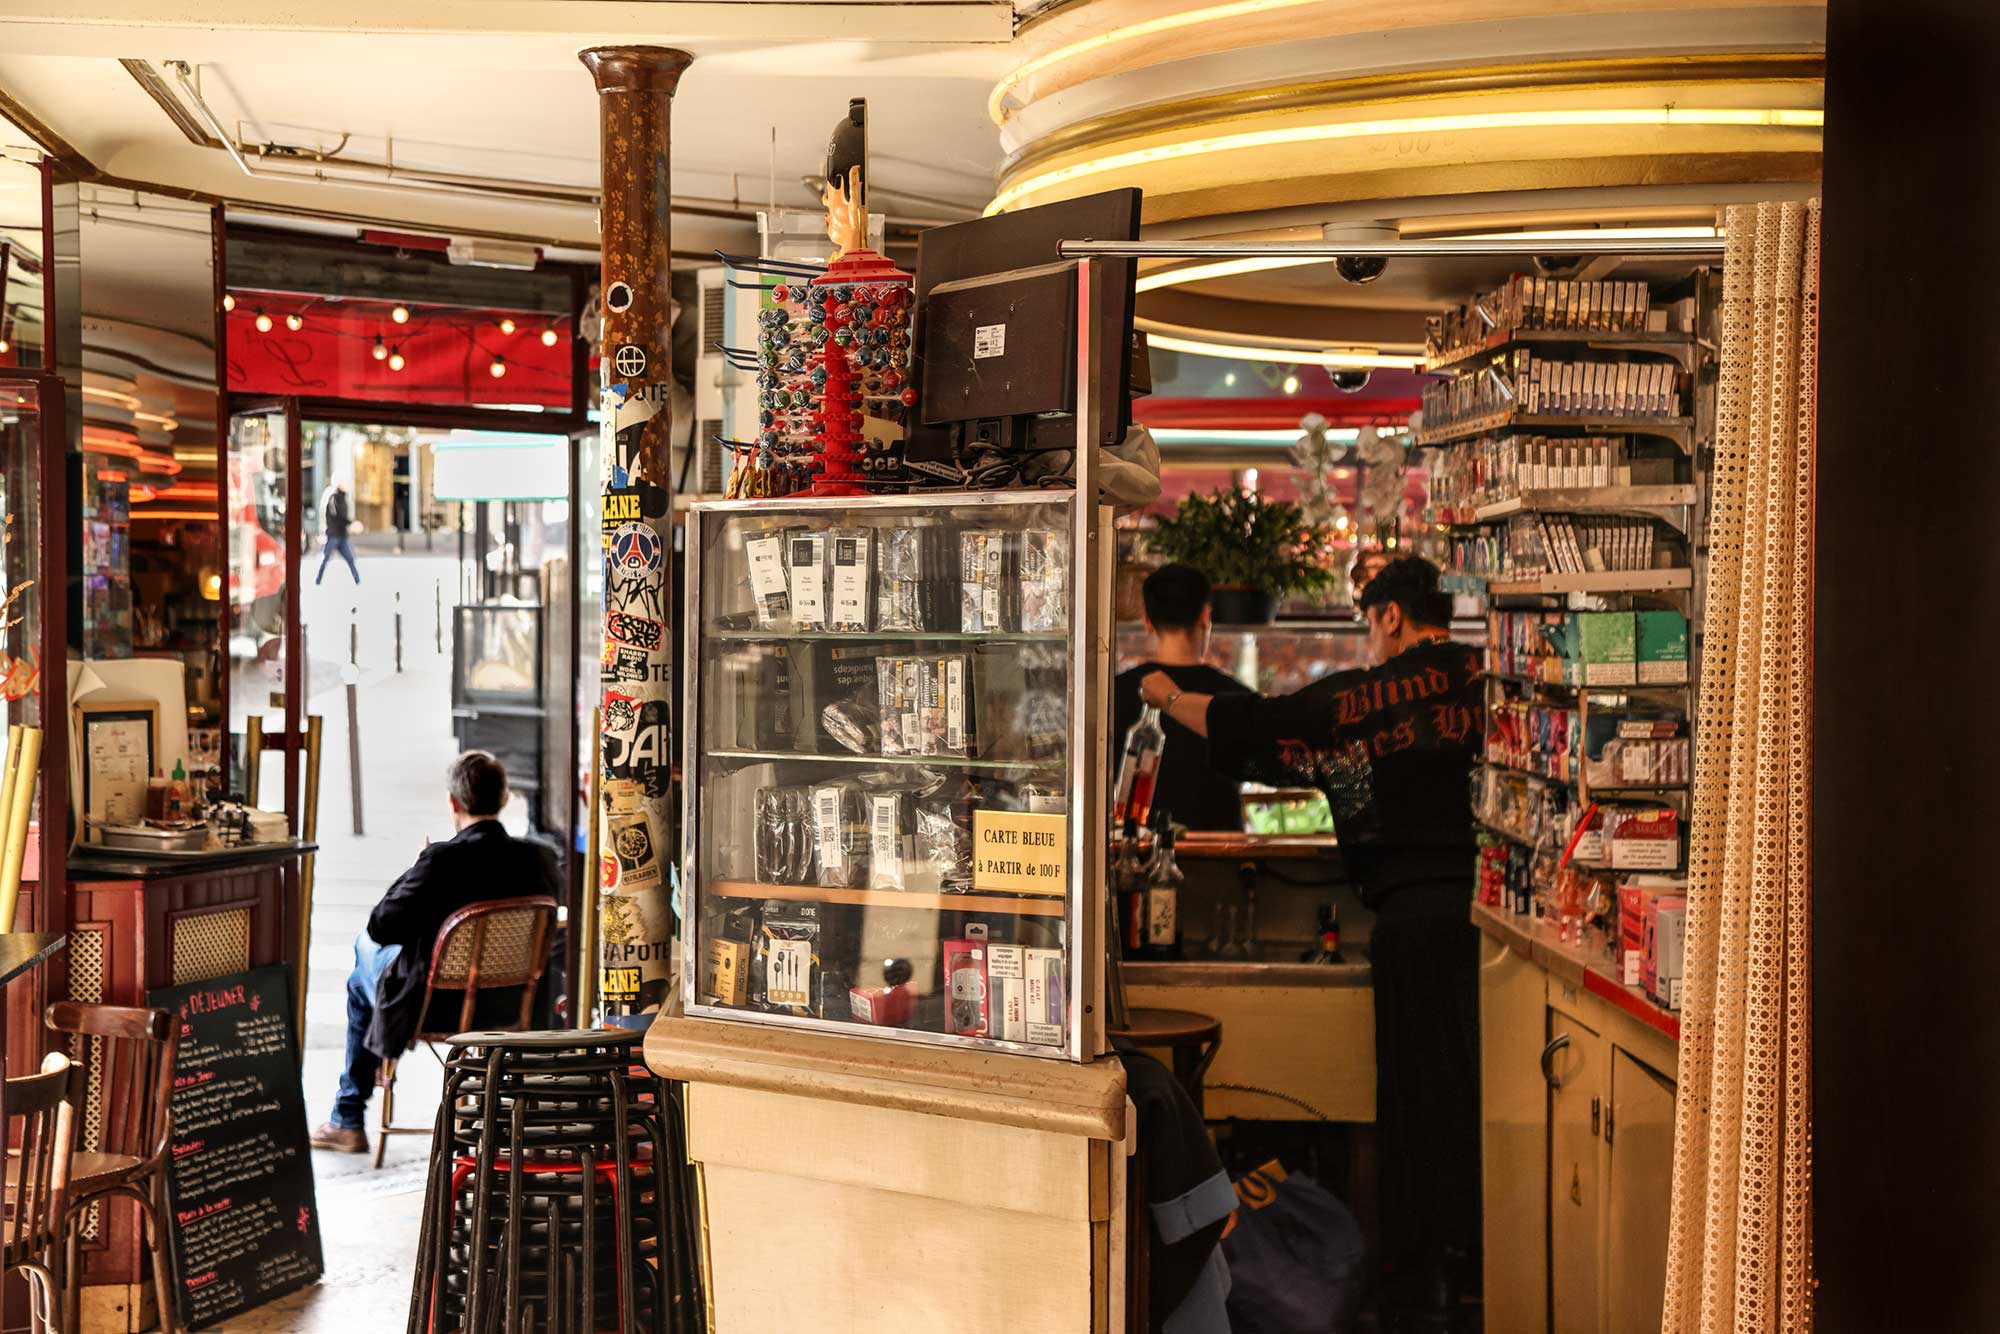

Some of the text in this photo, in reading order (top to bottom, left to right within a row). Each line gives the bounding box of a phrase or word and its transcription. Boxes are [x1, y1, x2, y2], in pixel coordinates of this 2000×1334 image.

[862, 456, 899, 472] OCB
[1332, 666, 1448, 725] Blind
[984, 829, 1055, 846] CARTE BLEUE
[978, 860, 983, 872] à
[988, 860, 1021, 875] PARTIR
[1026, 863, 1036, 876] de
